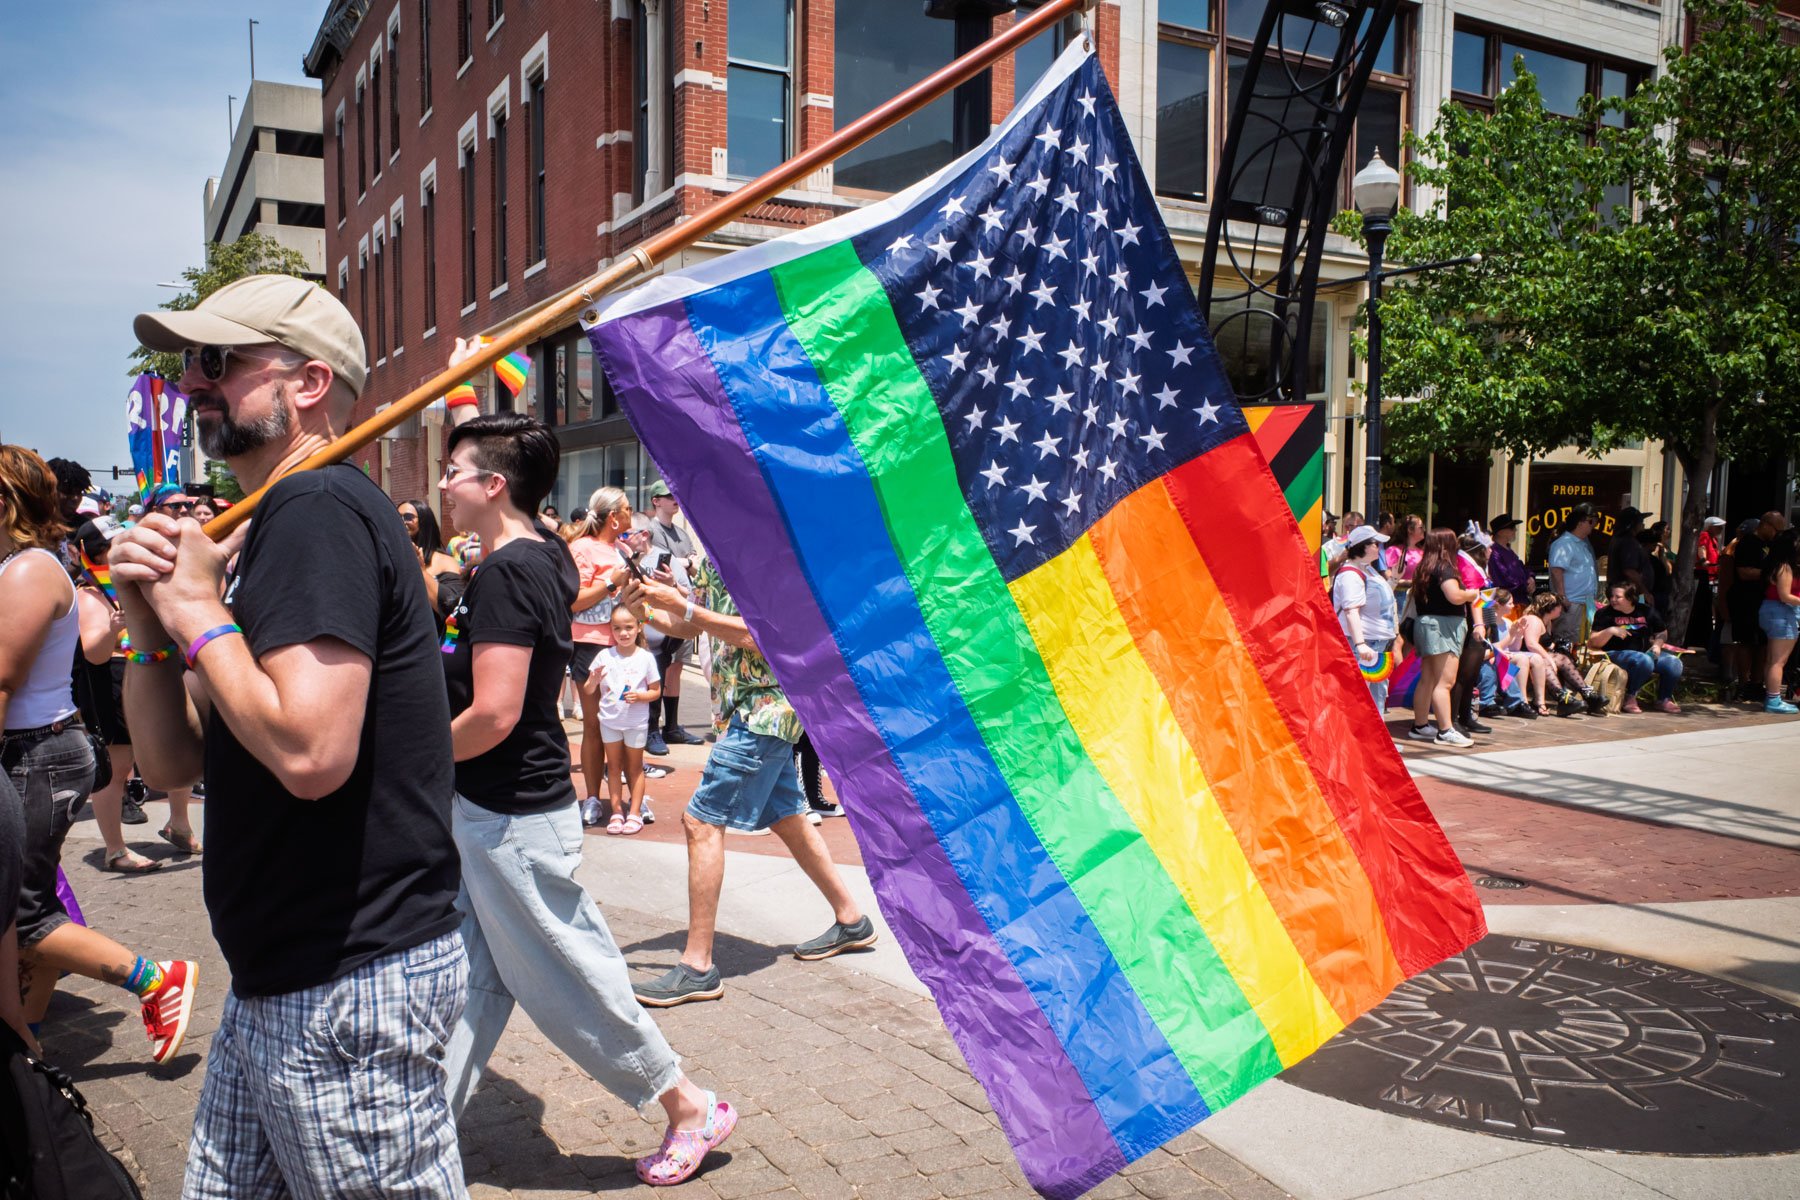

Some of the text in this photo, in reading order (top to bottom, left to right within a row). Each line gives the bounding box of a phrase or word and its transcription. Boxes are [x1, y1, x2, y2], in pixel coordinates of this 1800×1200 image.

[1552, 484, 1595, 496] PROPER
[1527, 506, 1617, 537] COFE
[1380, 1083, 1567, 1135] MALL
